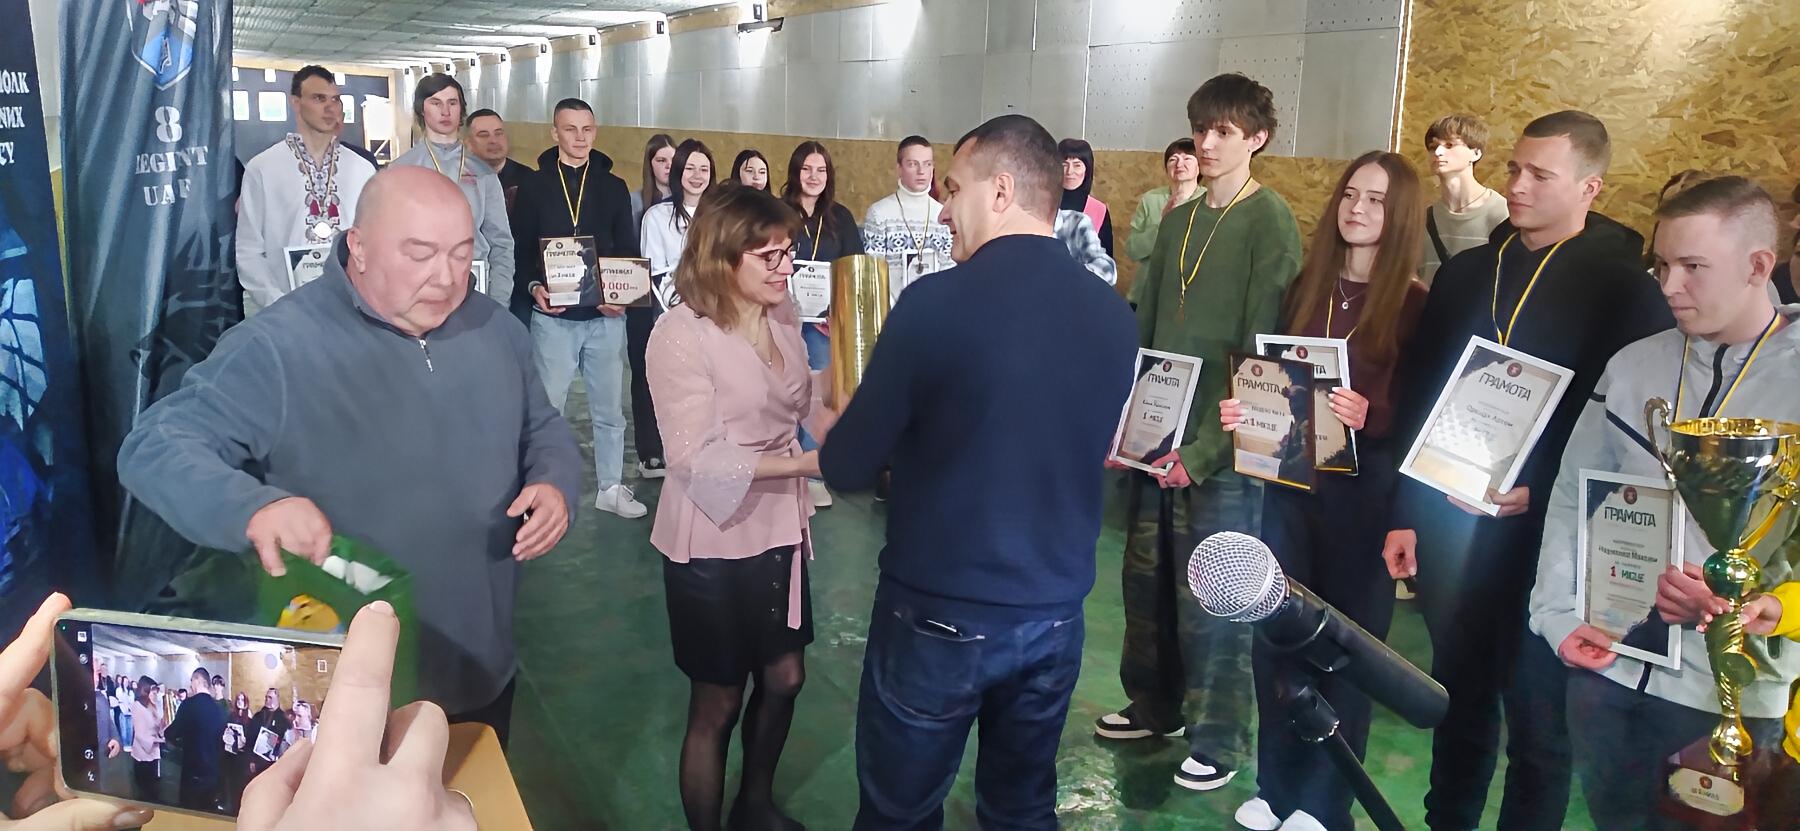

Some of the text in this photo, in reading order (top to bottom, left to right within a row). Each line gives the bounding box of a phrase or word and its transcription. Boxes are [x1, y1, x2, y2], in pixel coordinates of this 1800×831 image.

[155, 106, 183, 143] 8
[1237, 377, 1281, 394] ГРАМОТА
[1478, 372, 1532, 402] ГРАМОТА
[1250, 418, 1256, 427] 1
[1604, 506, 1657, 528] ГРАМОТА
[1610, 565, 1617, 577] 1
